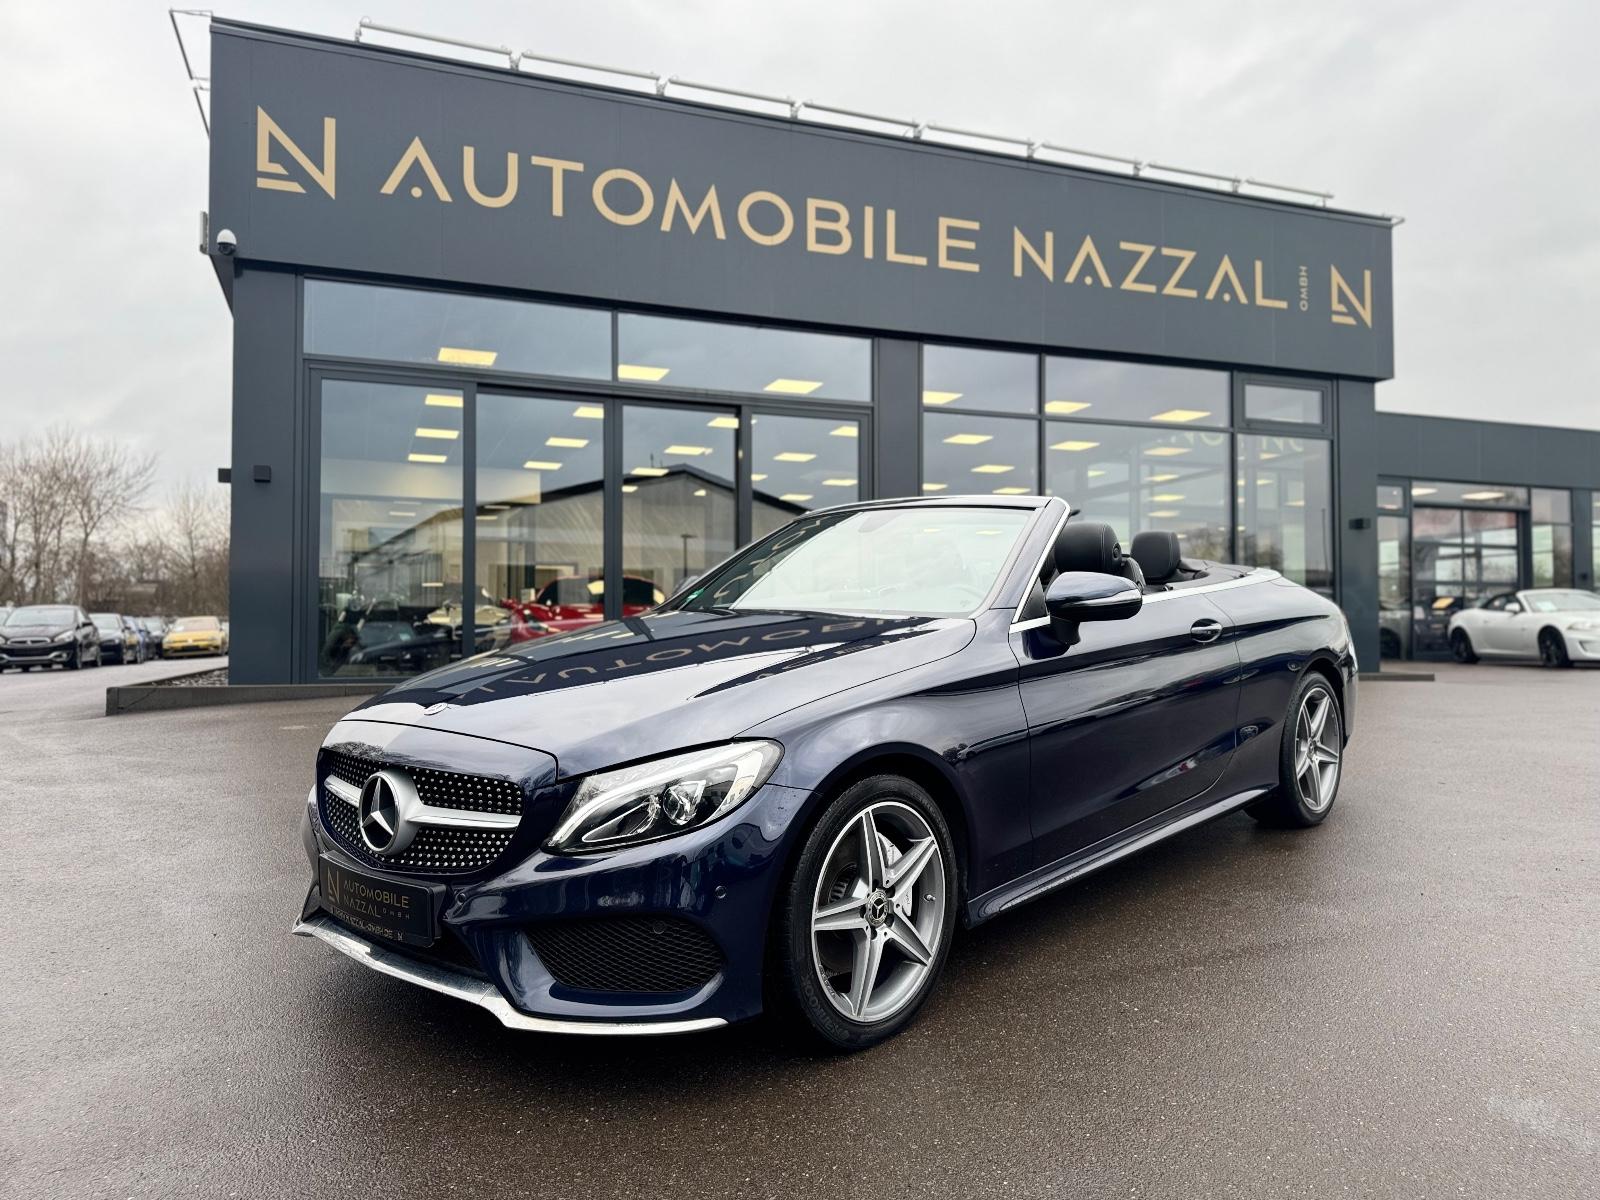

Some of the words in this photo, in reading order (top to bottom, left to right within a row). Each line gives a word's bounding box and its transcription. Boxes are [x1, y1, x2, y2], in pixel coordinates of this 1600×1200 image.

[381, 137, 980, 273] AUTOMOBILE
[1012, 227, 1288, 310] NAZZAL
[343, 879, 410, 909] AUTOMOBILE
[343, 894, 382, 918] NAZZAL
